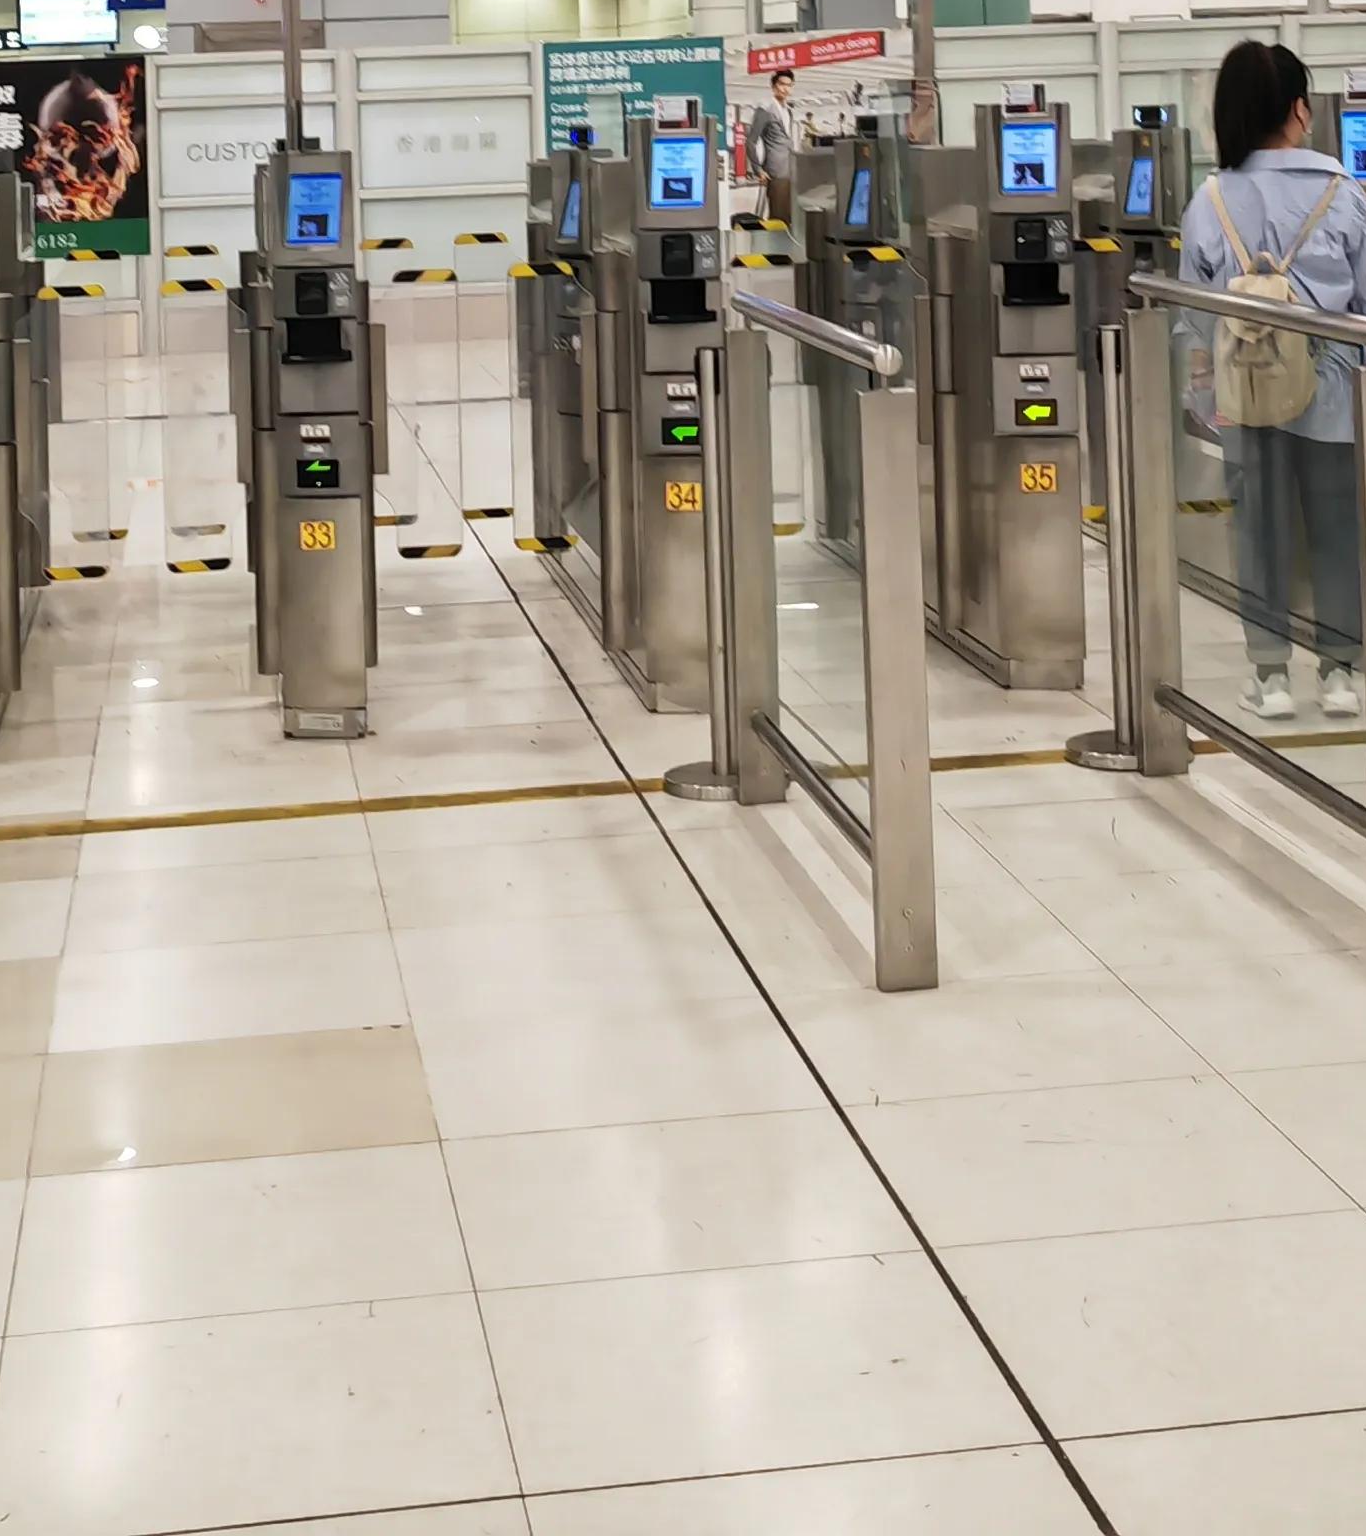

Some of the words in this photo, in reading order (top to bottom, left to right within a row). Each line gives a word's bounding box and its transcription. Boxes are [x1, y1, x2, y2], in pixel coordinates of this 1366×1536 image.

[186, 141, 275, 163] CUSTO
[1022, 466, 1053, 490] 35
[669, 484, 697, 509] 34
[302, 523, 333, 549] 33
